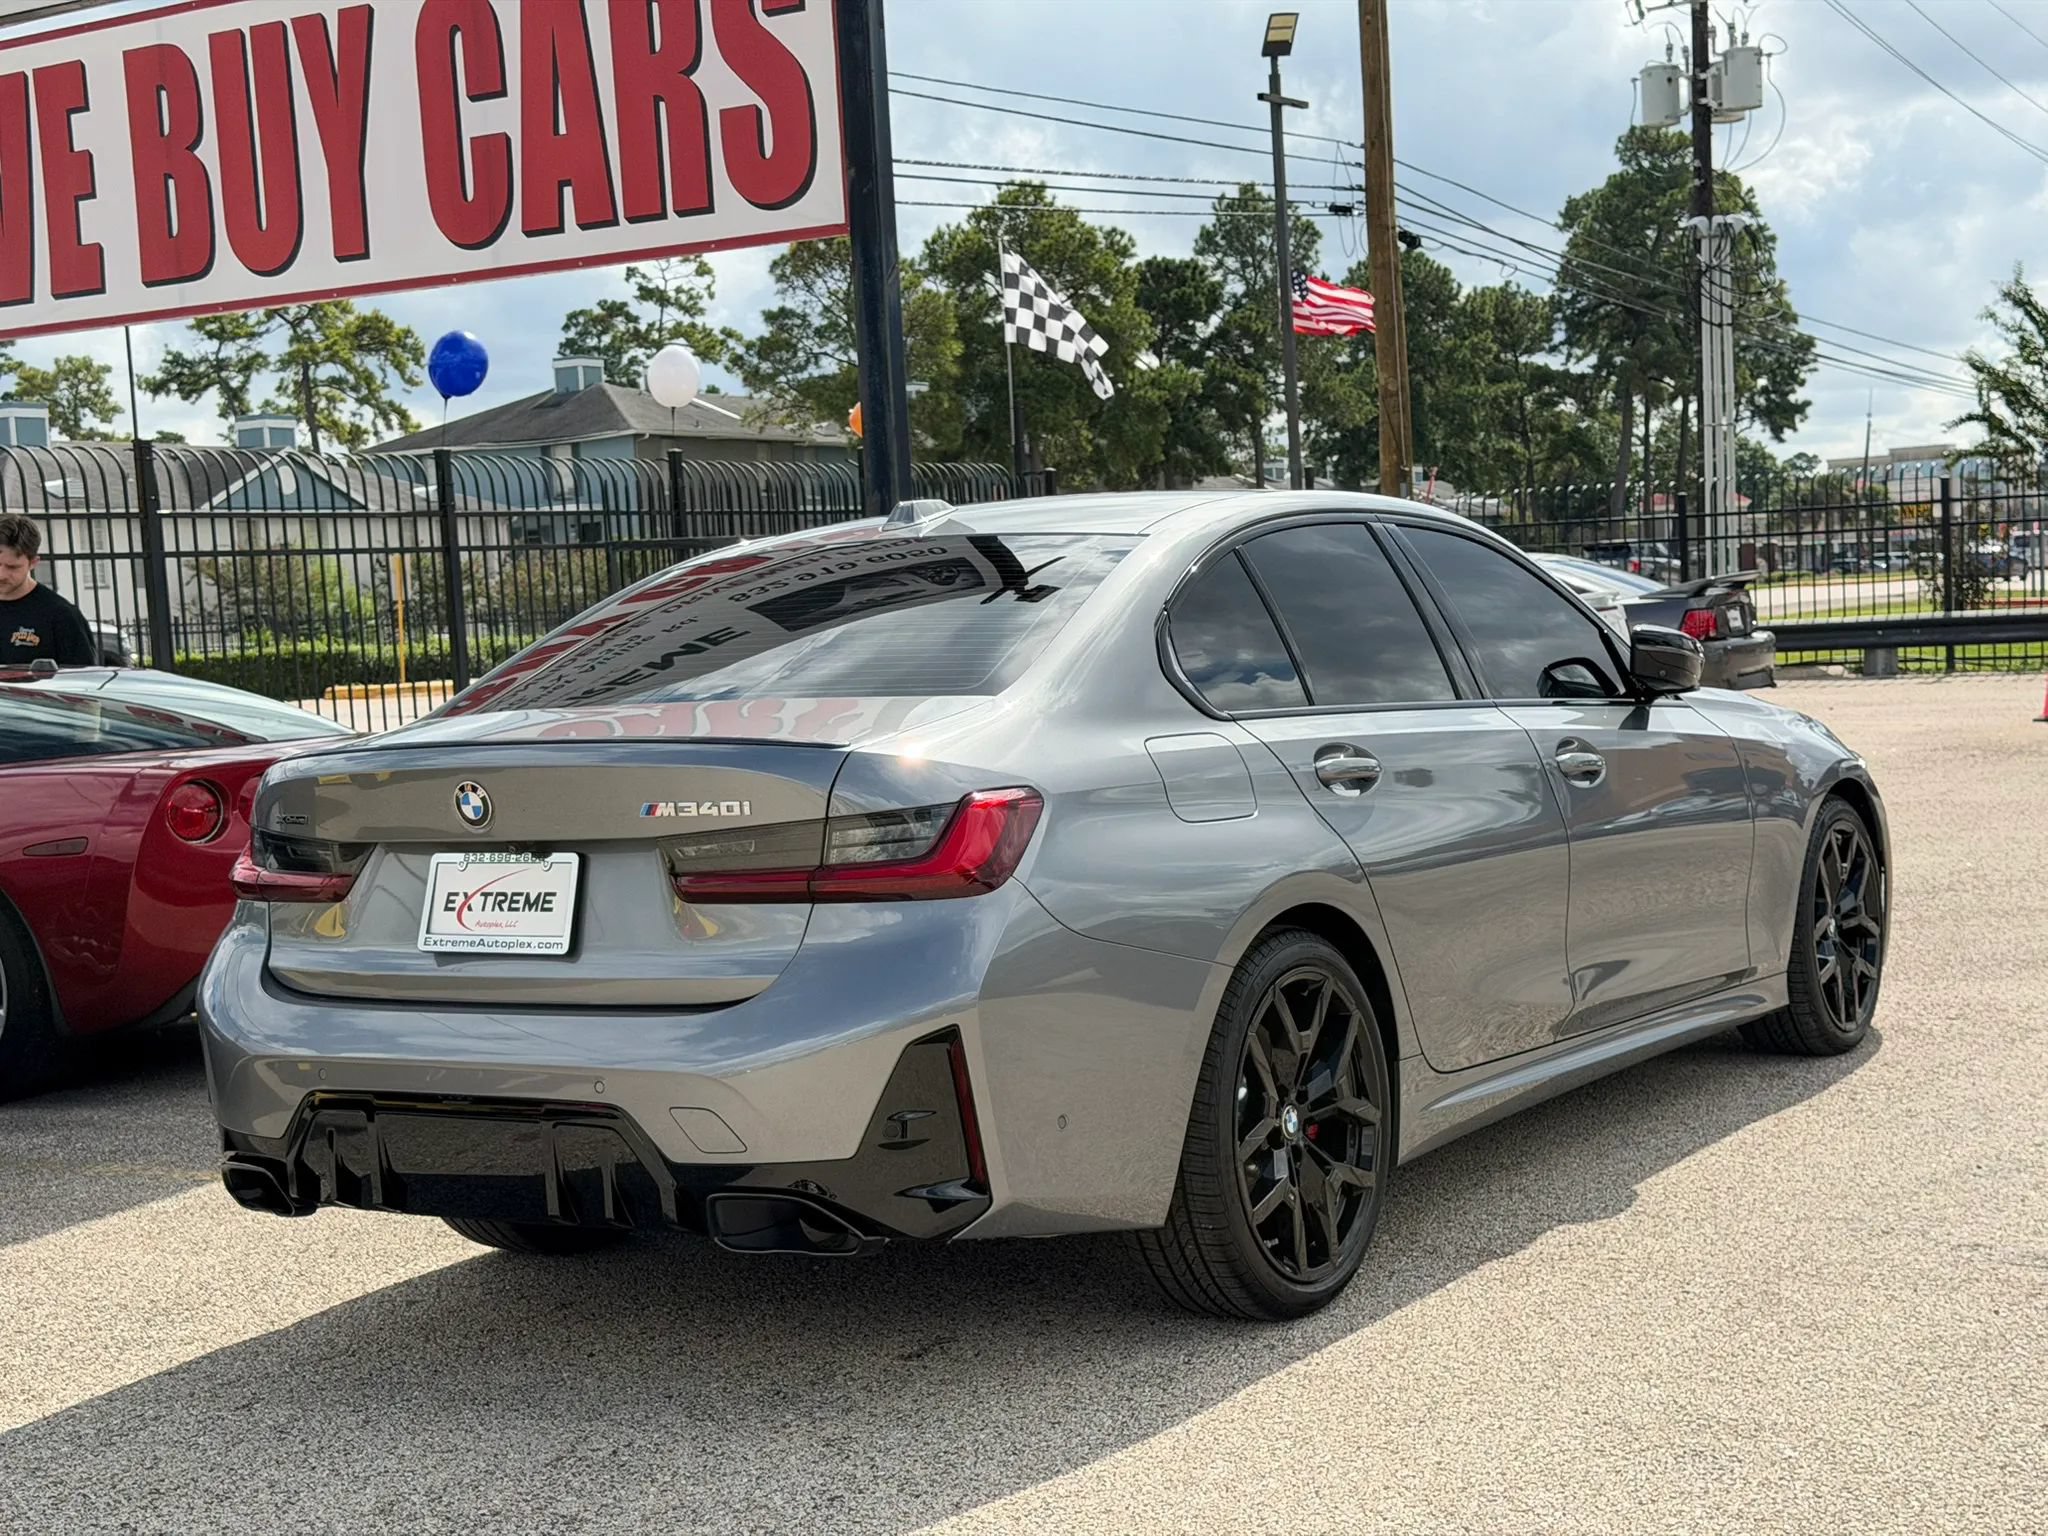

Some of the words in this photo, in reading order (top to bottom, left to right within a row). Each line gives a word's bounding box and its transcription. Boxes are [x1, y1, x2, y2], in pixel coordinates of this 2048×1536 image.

[122, 4, 375, 288] BUY
[414, 0, 817, 251] CARS
[443, 891, 557, 912] EXTREME
[423, 936, 564, 950] ExtremeAutoplex.com
